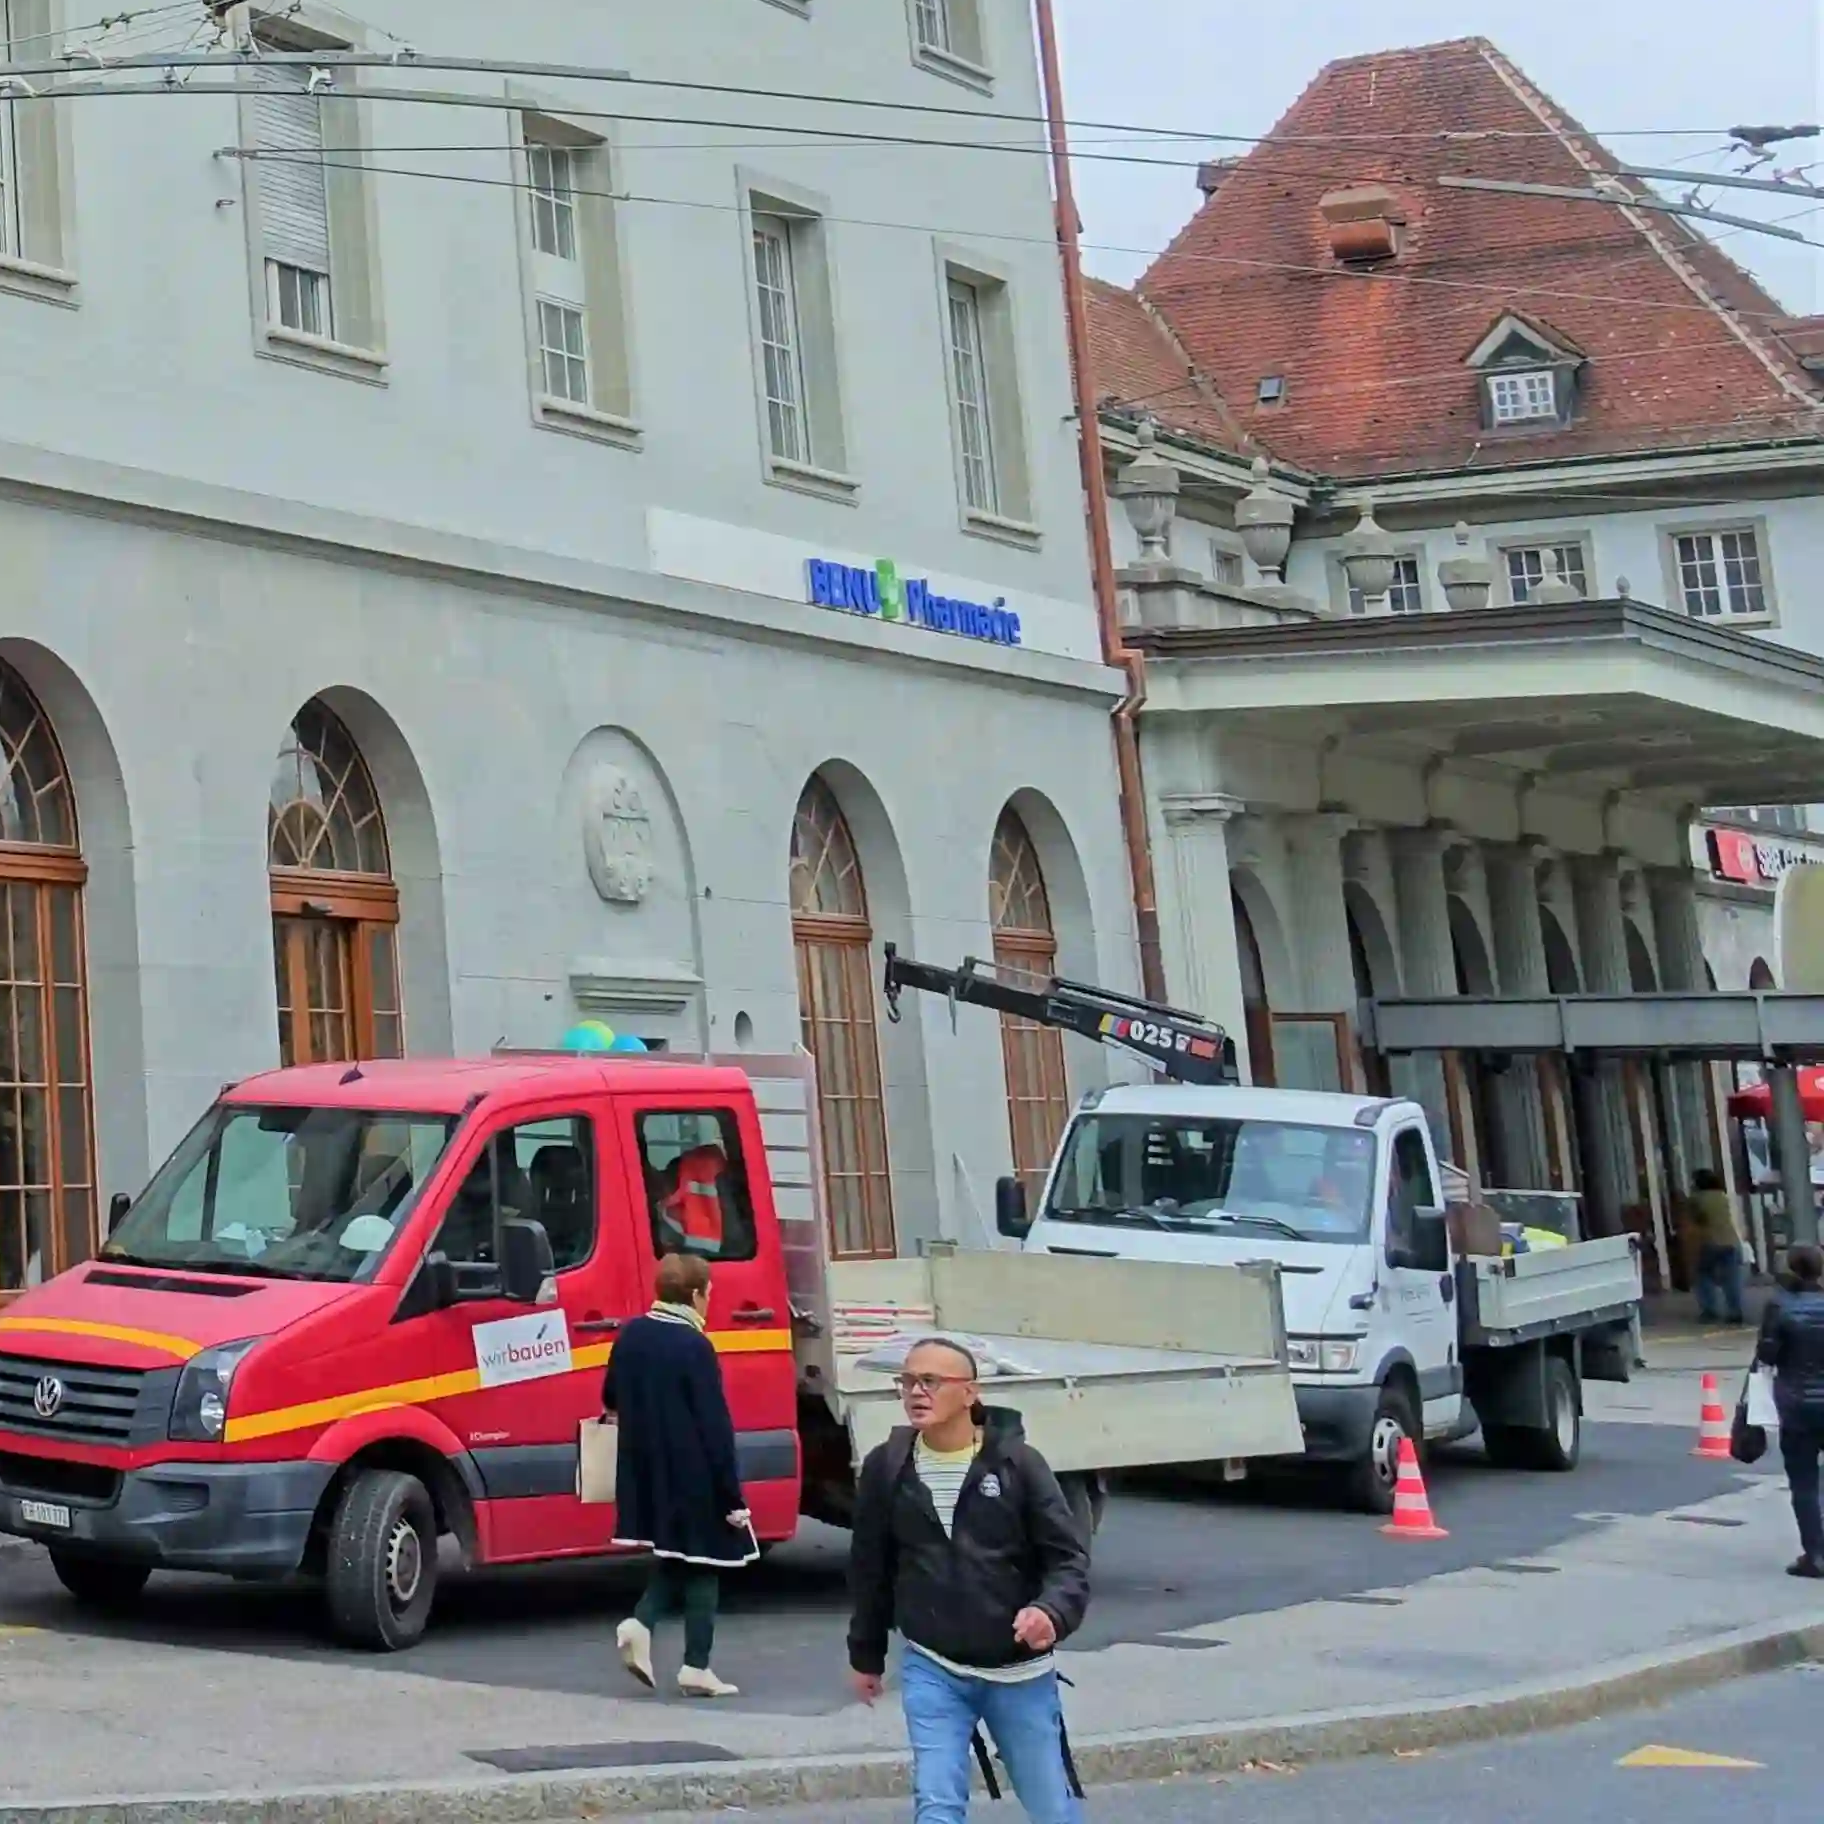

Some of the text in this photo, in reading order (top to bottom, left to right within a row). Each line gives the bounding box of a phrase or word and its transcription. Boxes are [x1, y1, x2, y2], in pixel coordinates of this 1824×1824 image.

[810, 558, 1021, 644] BENU Pharmacie
[1130, 1020, 1172, 1049] 025
[482, 1339, 565, 1368] wirbauen
